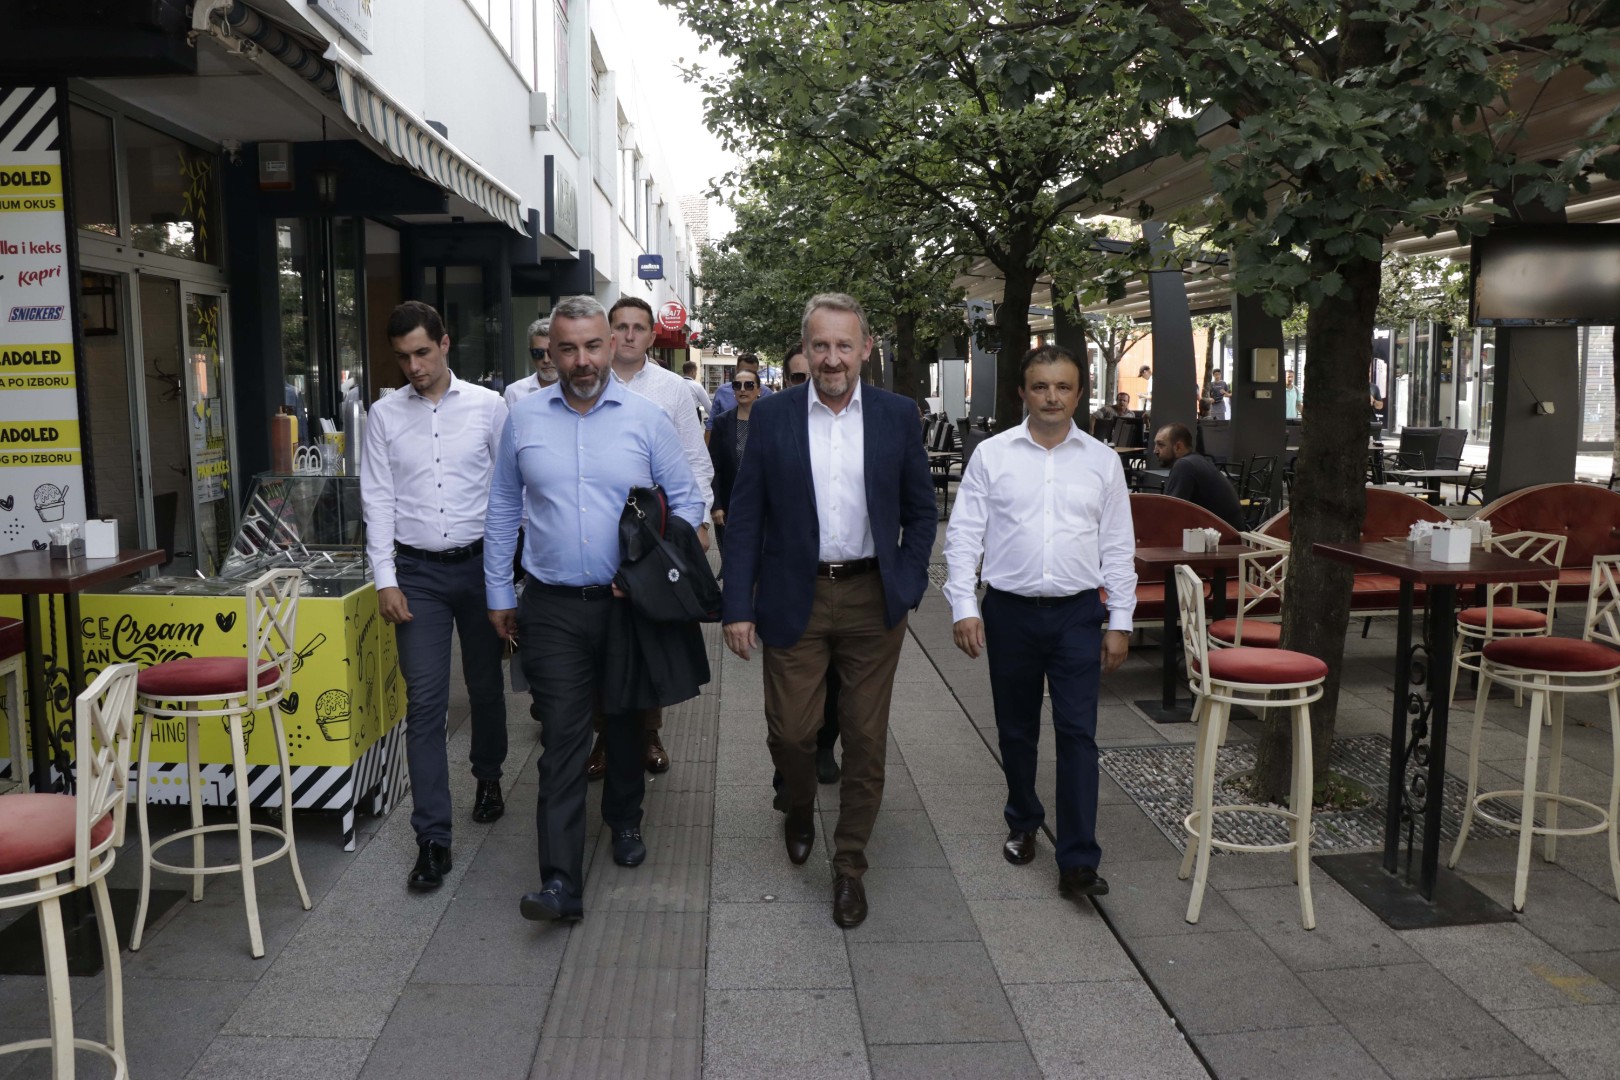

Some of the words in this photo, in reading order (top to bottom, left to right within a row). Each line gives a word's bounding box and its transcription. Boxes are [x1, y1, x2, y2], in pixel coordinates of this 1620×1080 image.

[23, 199, 56, 209] OKUS
[22, 241, 26, 254] i
[29, 240, 62, 254] keks
[18, 265, 62, 288] Kapri
[11, 307, 62, 320] SNICKERS
[0, 350, 61, 366] ADOLED
[8, 378, 24, 387] PO
[27, 376, 69, 387] IZBORU
[0, 427, 59, 443] ADOLED
[0, 454, 10, 464] G
[12, 454, 28, 464] PO
[31, 453, 72, 464] IZBORU
[80, 616, 112, 640] CE
[111, 613, 204, 660] Cream
[83, 648, 111, 664] AN
